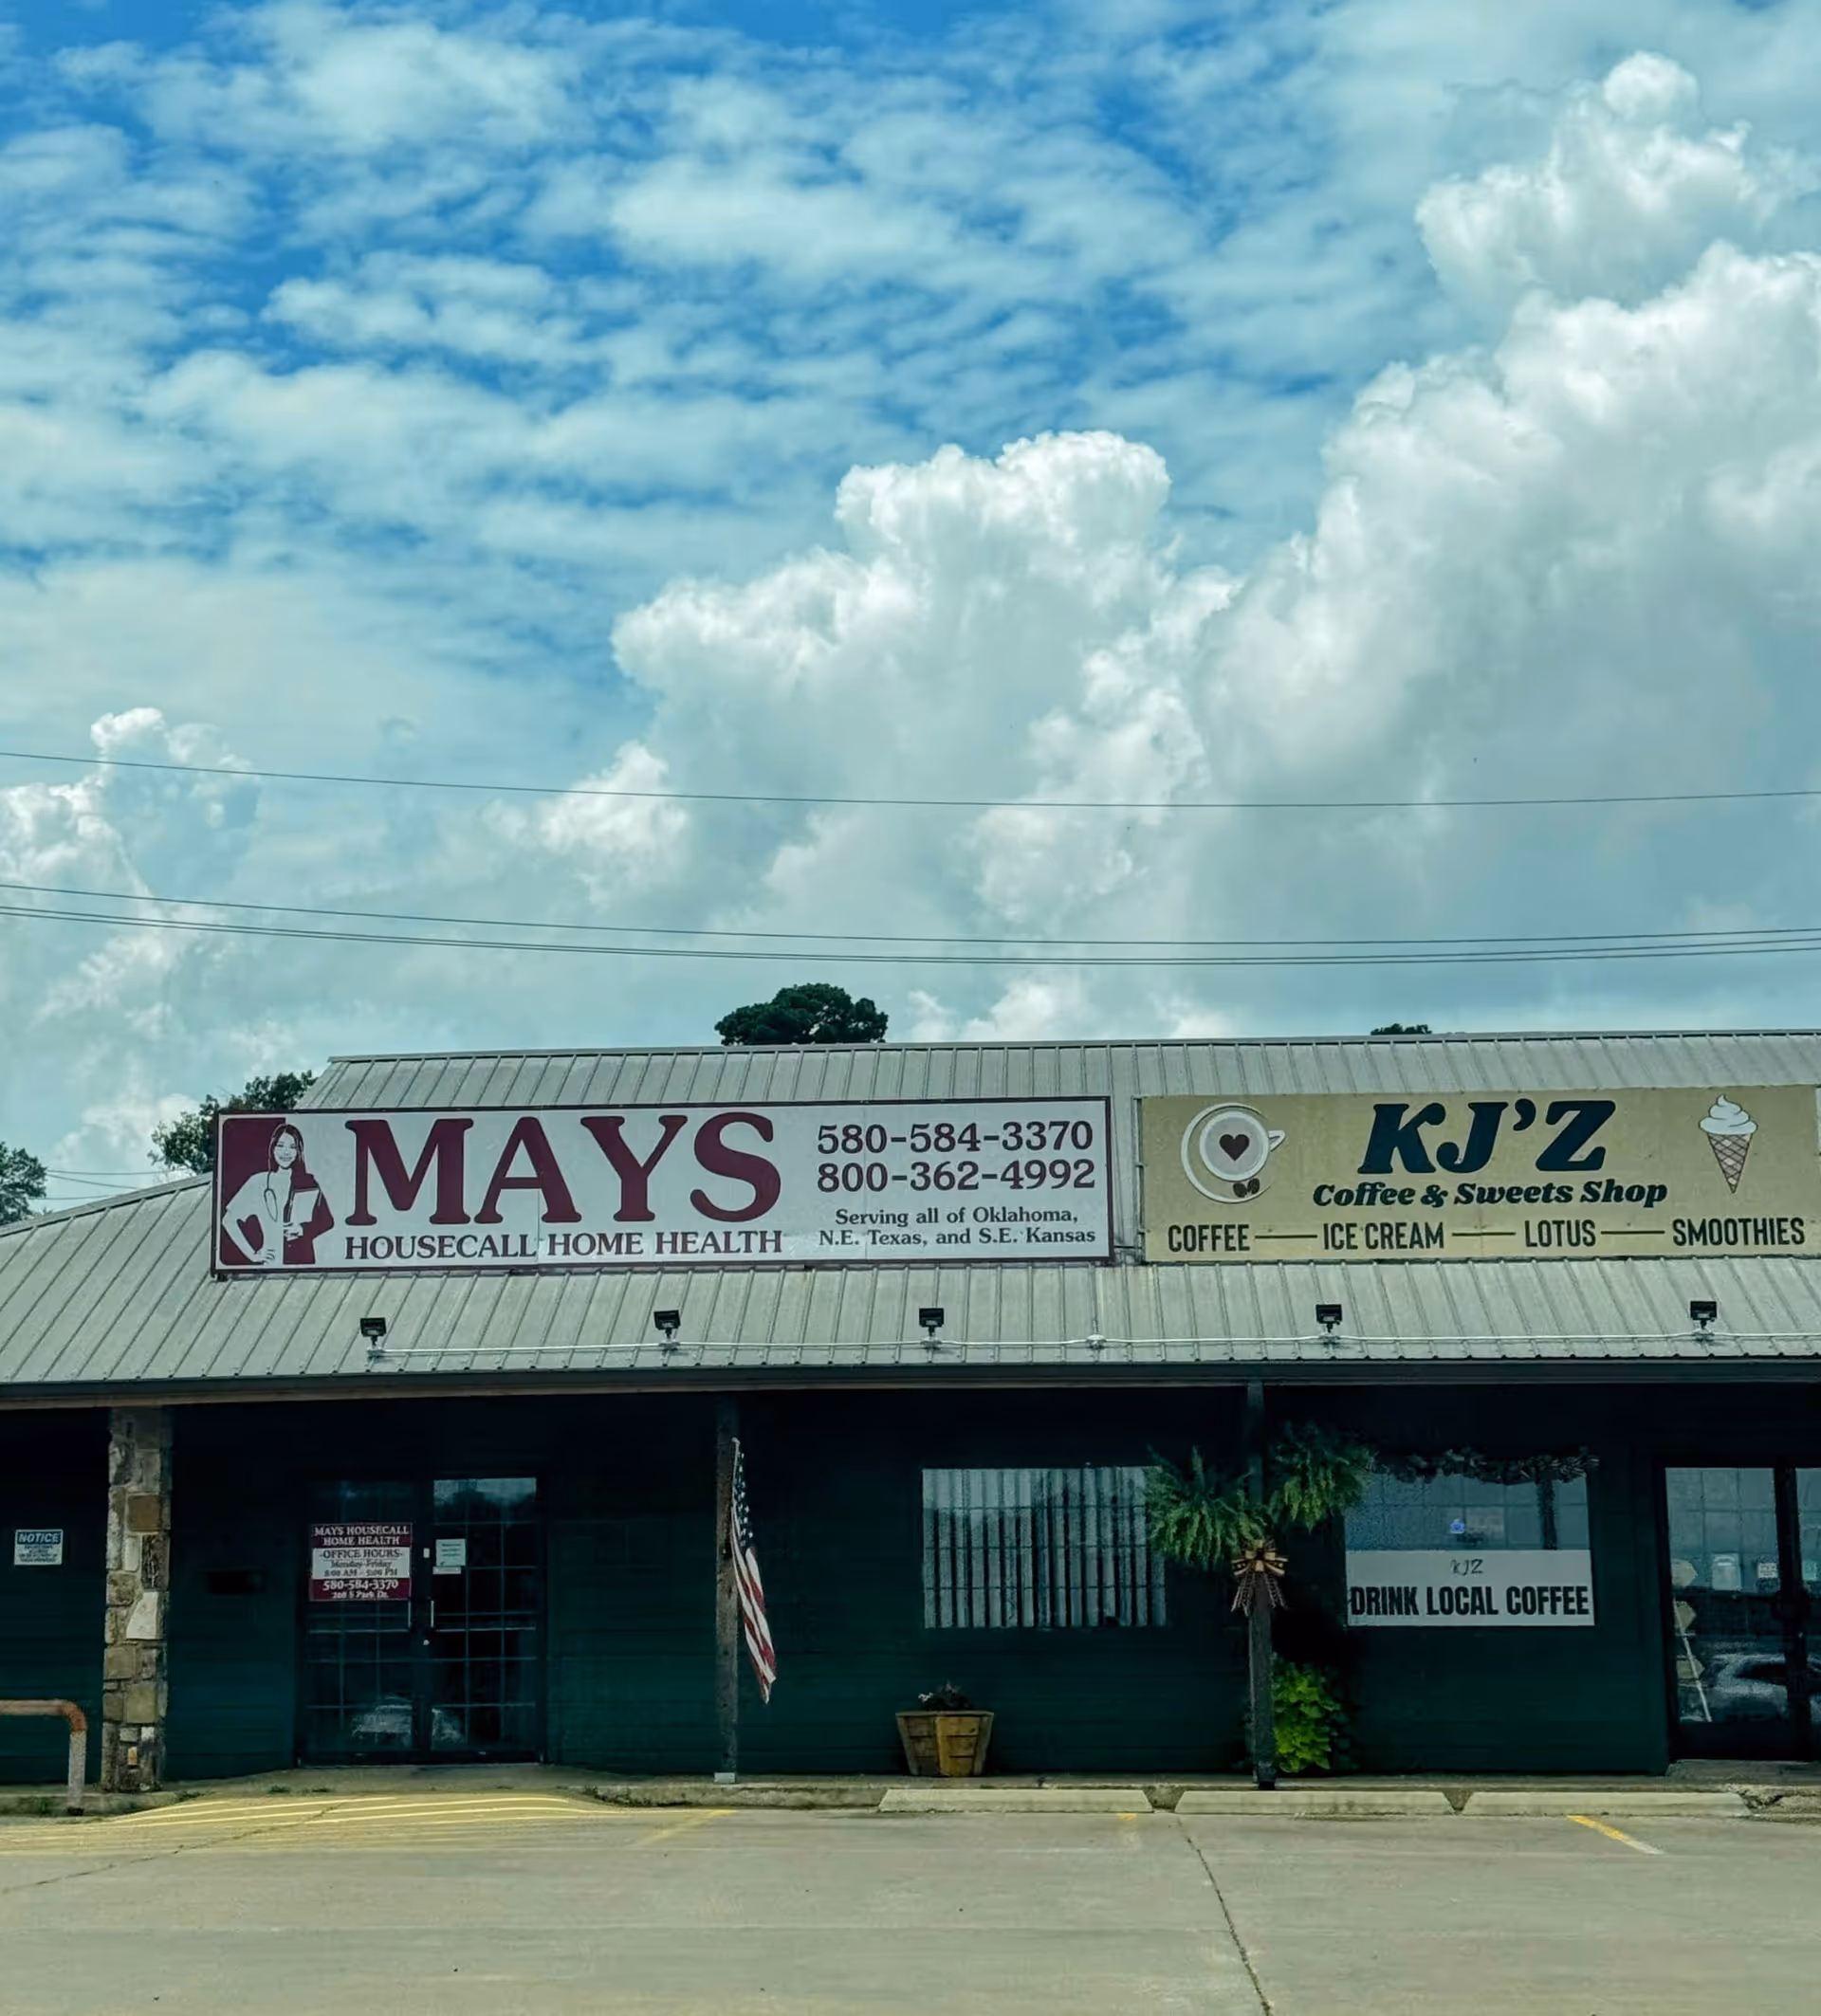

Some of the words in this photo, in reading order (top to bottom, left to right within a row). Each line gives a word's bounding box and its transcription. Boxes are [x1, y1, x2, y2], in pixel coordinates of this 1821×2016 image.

[817, 1121, 1094, 1155] 580-584-3370
[1357, 1098, 1616, 1175] KJ'Z
[344, 1111, 782, 1226] MAYS
[817, 1159, 1095, 1193] 800-362-4992
[1314, 1181, 1413, 1207] Coffee
[1421, 1182, 1447, 1207] &
[1454, 1181, 1573, 1205] Sweets
[1579, 1179, 1668, 1208] Shop
[835, 1208, 909, 1227] Serving
[915, 1207, 939, 1224] all
[947, 1206, 966, 1223] of
[972, 1206, 1078, 1224] Oklahoma,
[344, 1234, 537, 1260] HOUSECALL
[547, 1232, 644, 1256] HOME
[655, 1230, 782, 1255] HEALTH
[819, 1230, 859, 1247] N.E.
[867, 1229, 928, 1248] Texas,
[935, 1228, 971, 1245] and
[979, 1228, 1018, 1245] S.E.
[1026, 1227, 1096, 1244] Kansas
[1168, 1223, 1251, 1253] COFFEE
[1322, 1221, 1359, 1251] ICE
[1365, 1221, 1444, 1251] CREAM
[1524, 1219, 1596, 1248] LOTUS
[1672, 1217, 1806, 1247] SMOOTHIES
[19, 1532, 60, 1543] NOTICE
[314, 1526, 344, 1536] MAYS
[346, 1525, 410, 1535] HOUSECALL
[322, 1536, 355, 1546] HOME
[358, 1535, 400, 1545] HEALTH
[322, 1579, 399, 1591] 580-584-3370
[1351, 1585, 1420, 1616] DRINK
[1426, 1585, 1499, 1616] LOCAL
[1506, 1585, 1590, 1616] COFFEE
